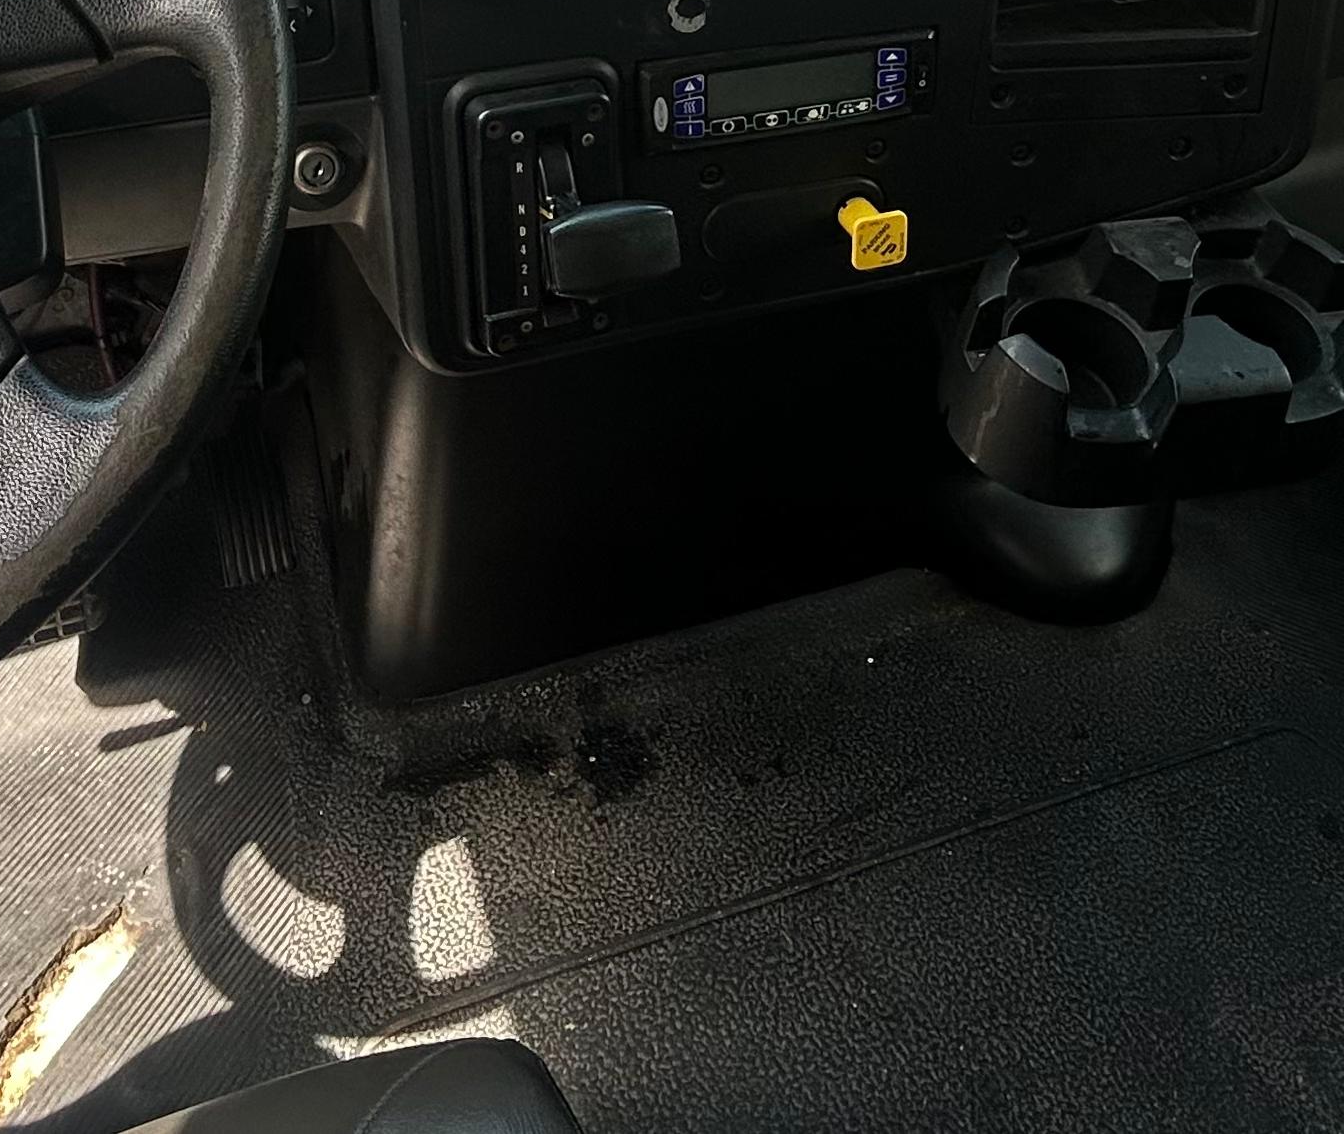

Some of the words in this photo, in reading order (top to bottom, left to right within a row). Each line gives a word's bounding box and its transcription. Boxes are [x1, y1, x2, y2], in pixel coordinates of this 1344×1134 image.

[516, 162, 524, 173] R
[518, 204, 526, 216] N
[519, 226, 527, 237] D
[520, 244, 527, 255] 4
[521, 264, 528, 275] 2
[523, 285, 529, 297] 1
